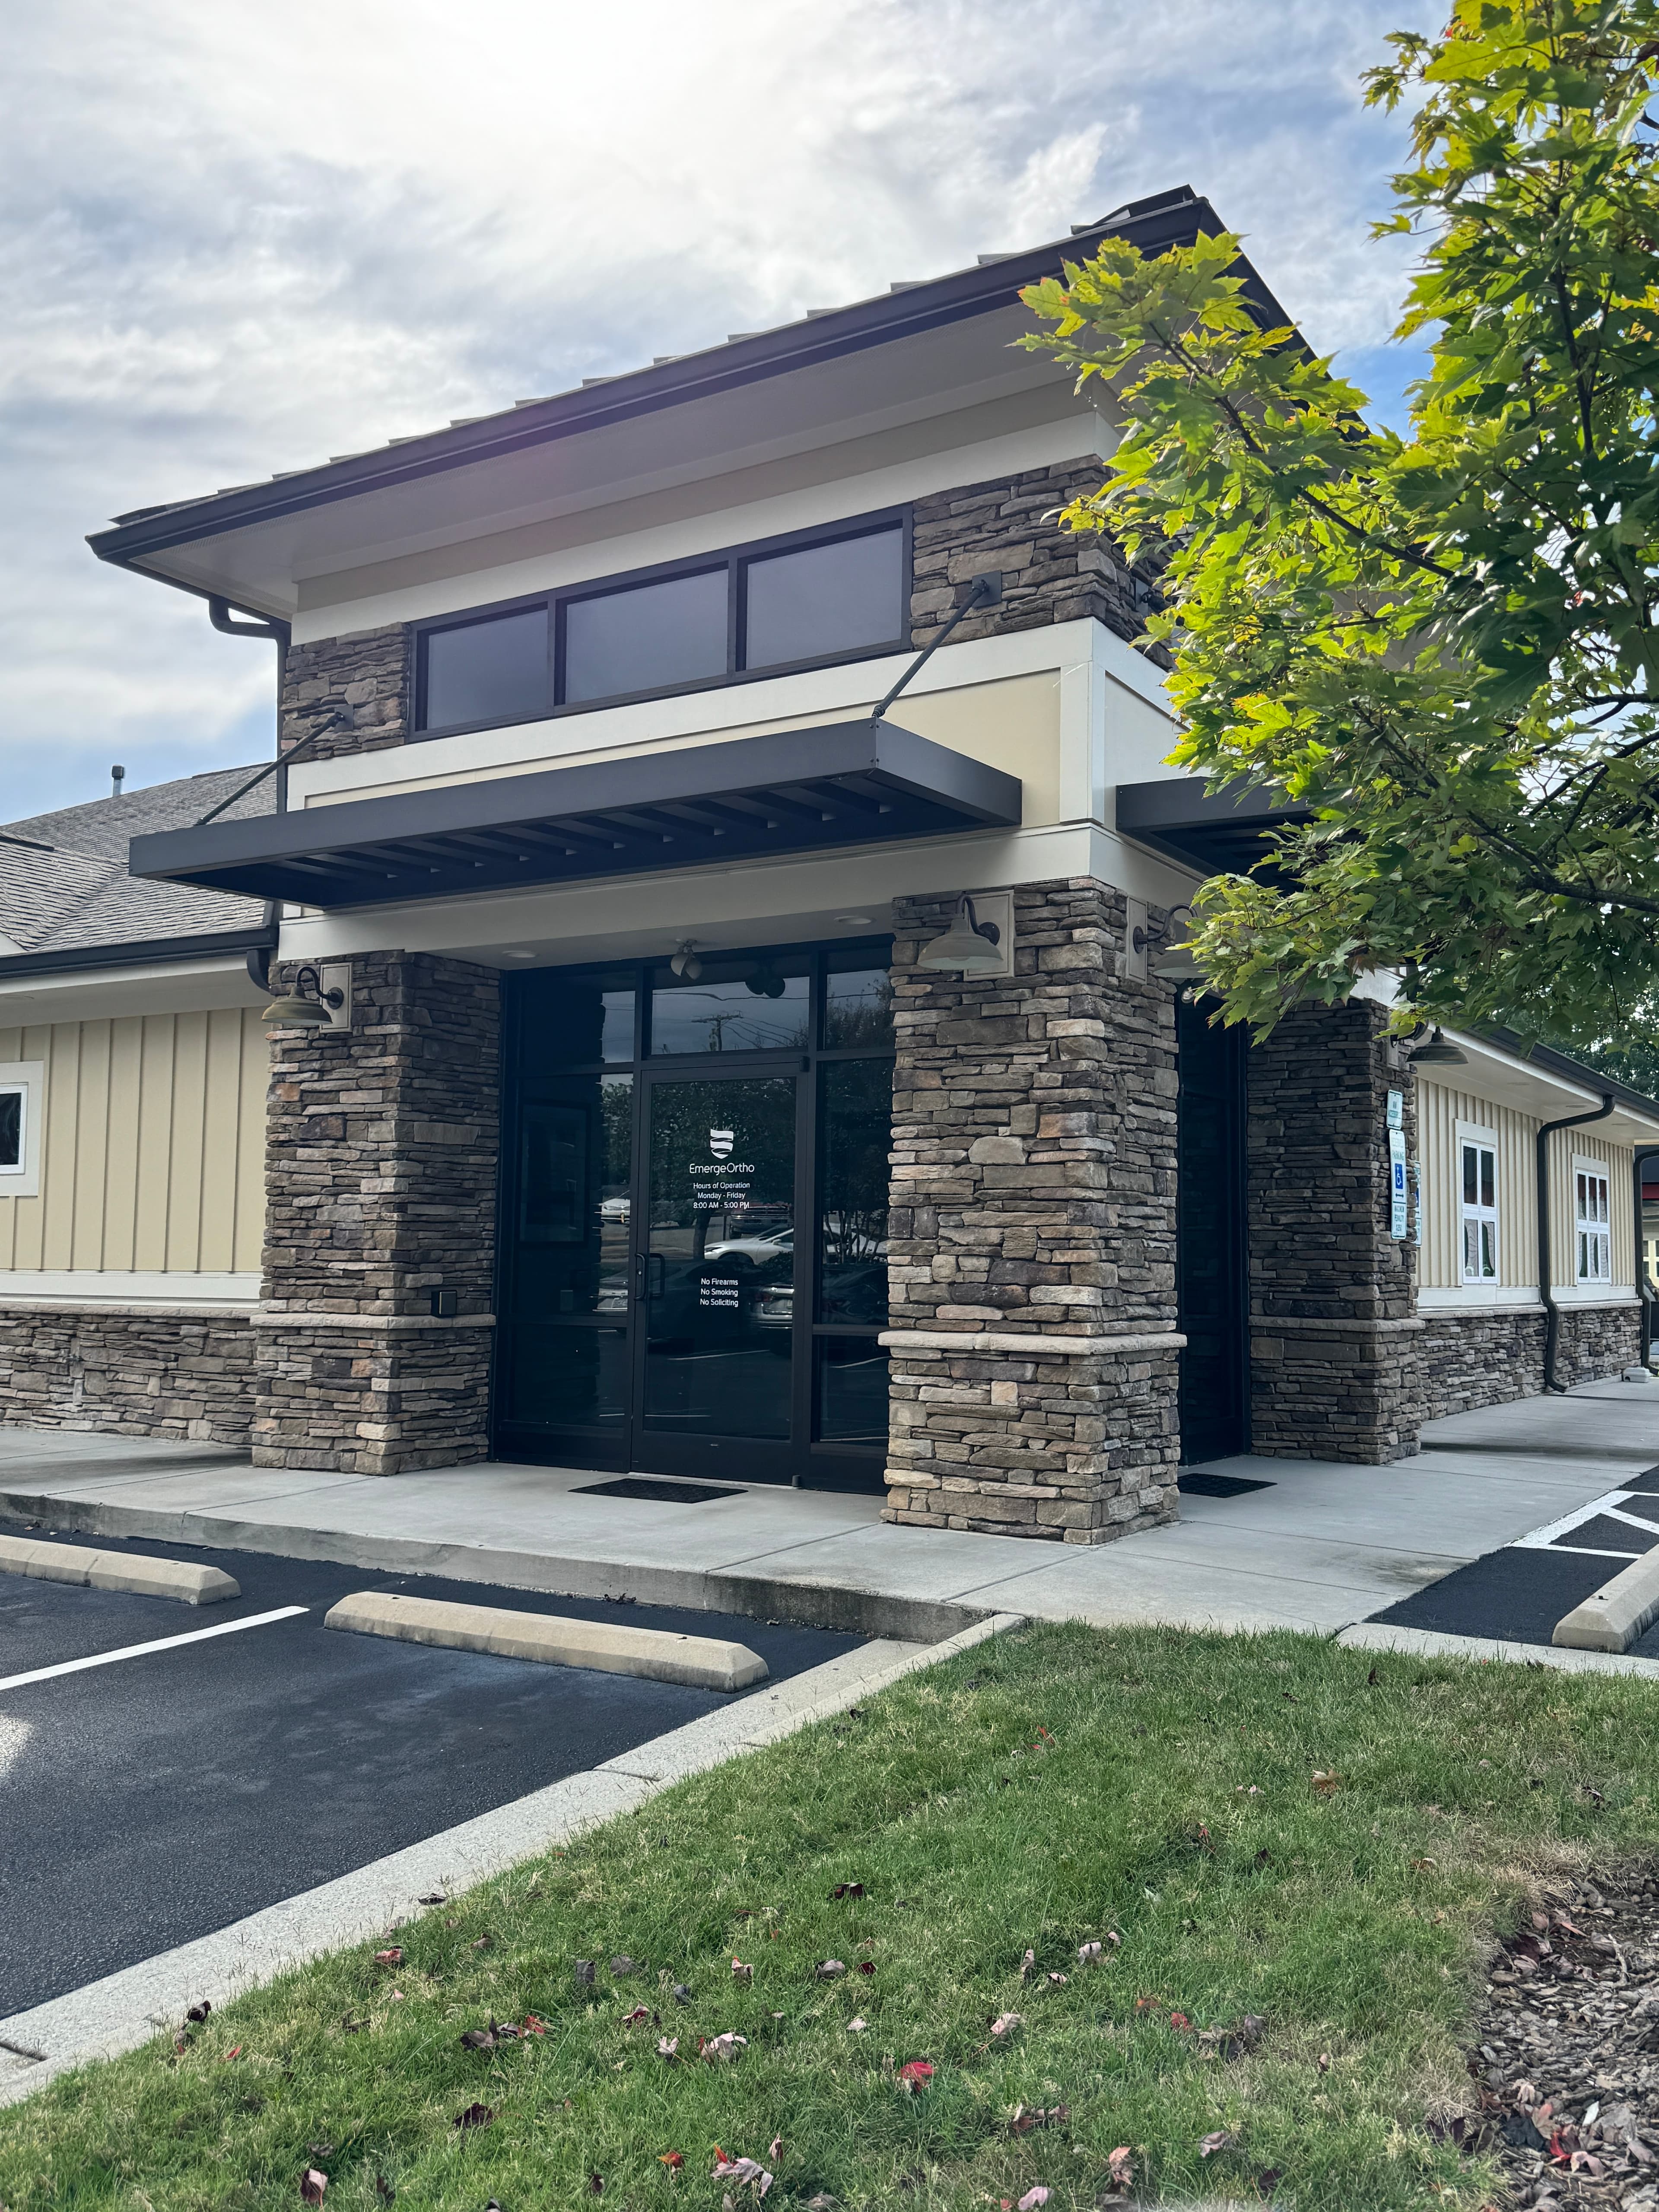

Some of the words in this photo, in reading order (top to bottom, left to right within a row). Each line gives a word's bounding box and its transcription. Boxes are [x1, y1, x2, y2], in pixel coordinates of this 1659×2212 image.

[690, 1163, 754, 1176] EmergeOrtho
[698, 1192, 721, 1200] Monday
[711, 1288, 738, 1297] Smoking
[711, 1299, 738, 1307] Soliciting
